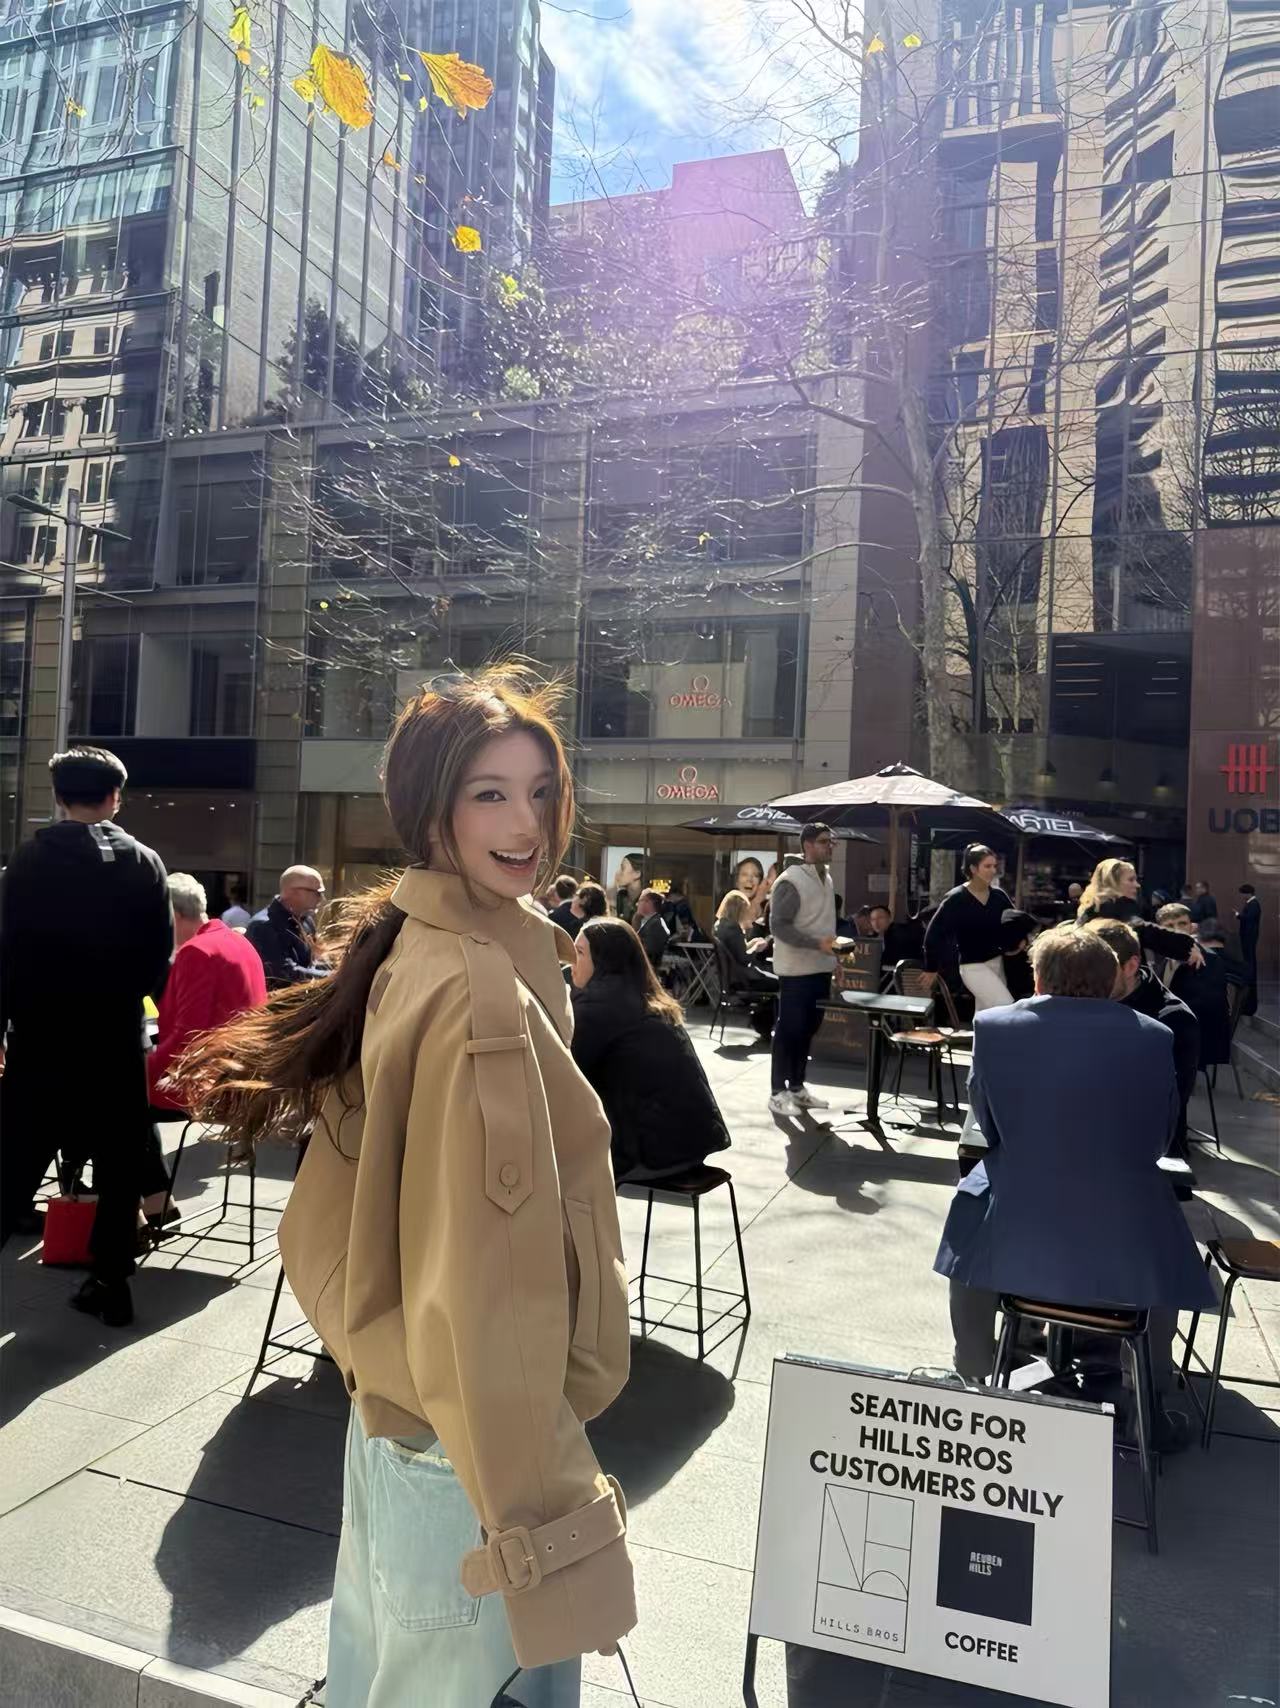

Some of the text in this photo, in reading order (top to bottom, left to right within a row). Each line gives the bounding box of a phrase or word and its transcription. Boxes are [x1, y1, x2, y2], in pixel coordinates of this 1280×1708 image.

[670, 692, 733, 709] OMEGA
[657, 783, 719, 800] OMEGA
[1209, 807, 1280, 834] UOB
[850, 1392, 1027, 1444] SEATING FOR
[859, 1426, 1013, 1475] HILLS BROS
[809, 1450, 1064, 1518] CUSTOMERS ONLY
[968, 1562, 992, 1576] HILLS
[970, 1551, 1002, 1567] REUBEN
[820, 1617, 899, 1642] HILLS BROS
[944, 1632, 1019, 1664] COFFEE
